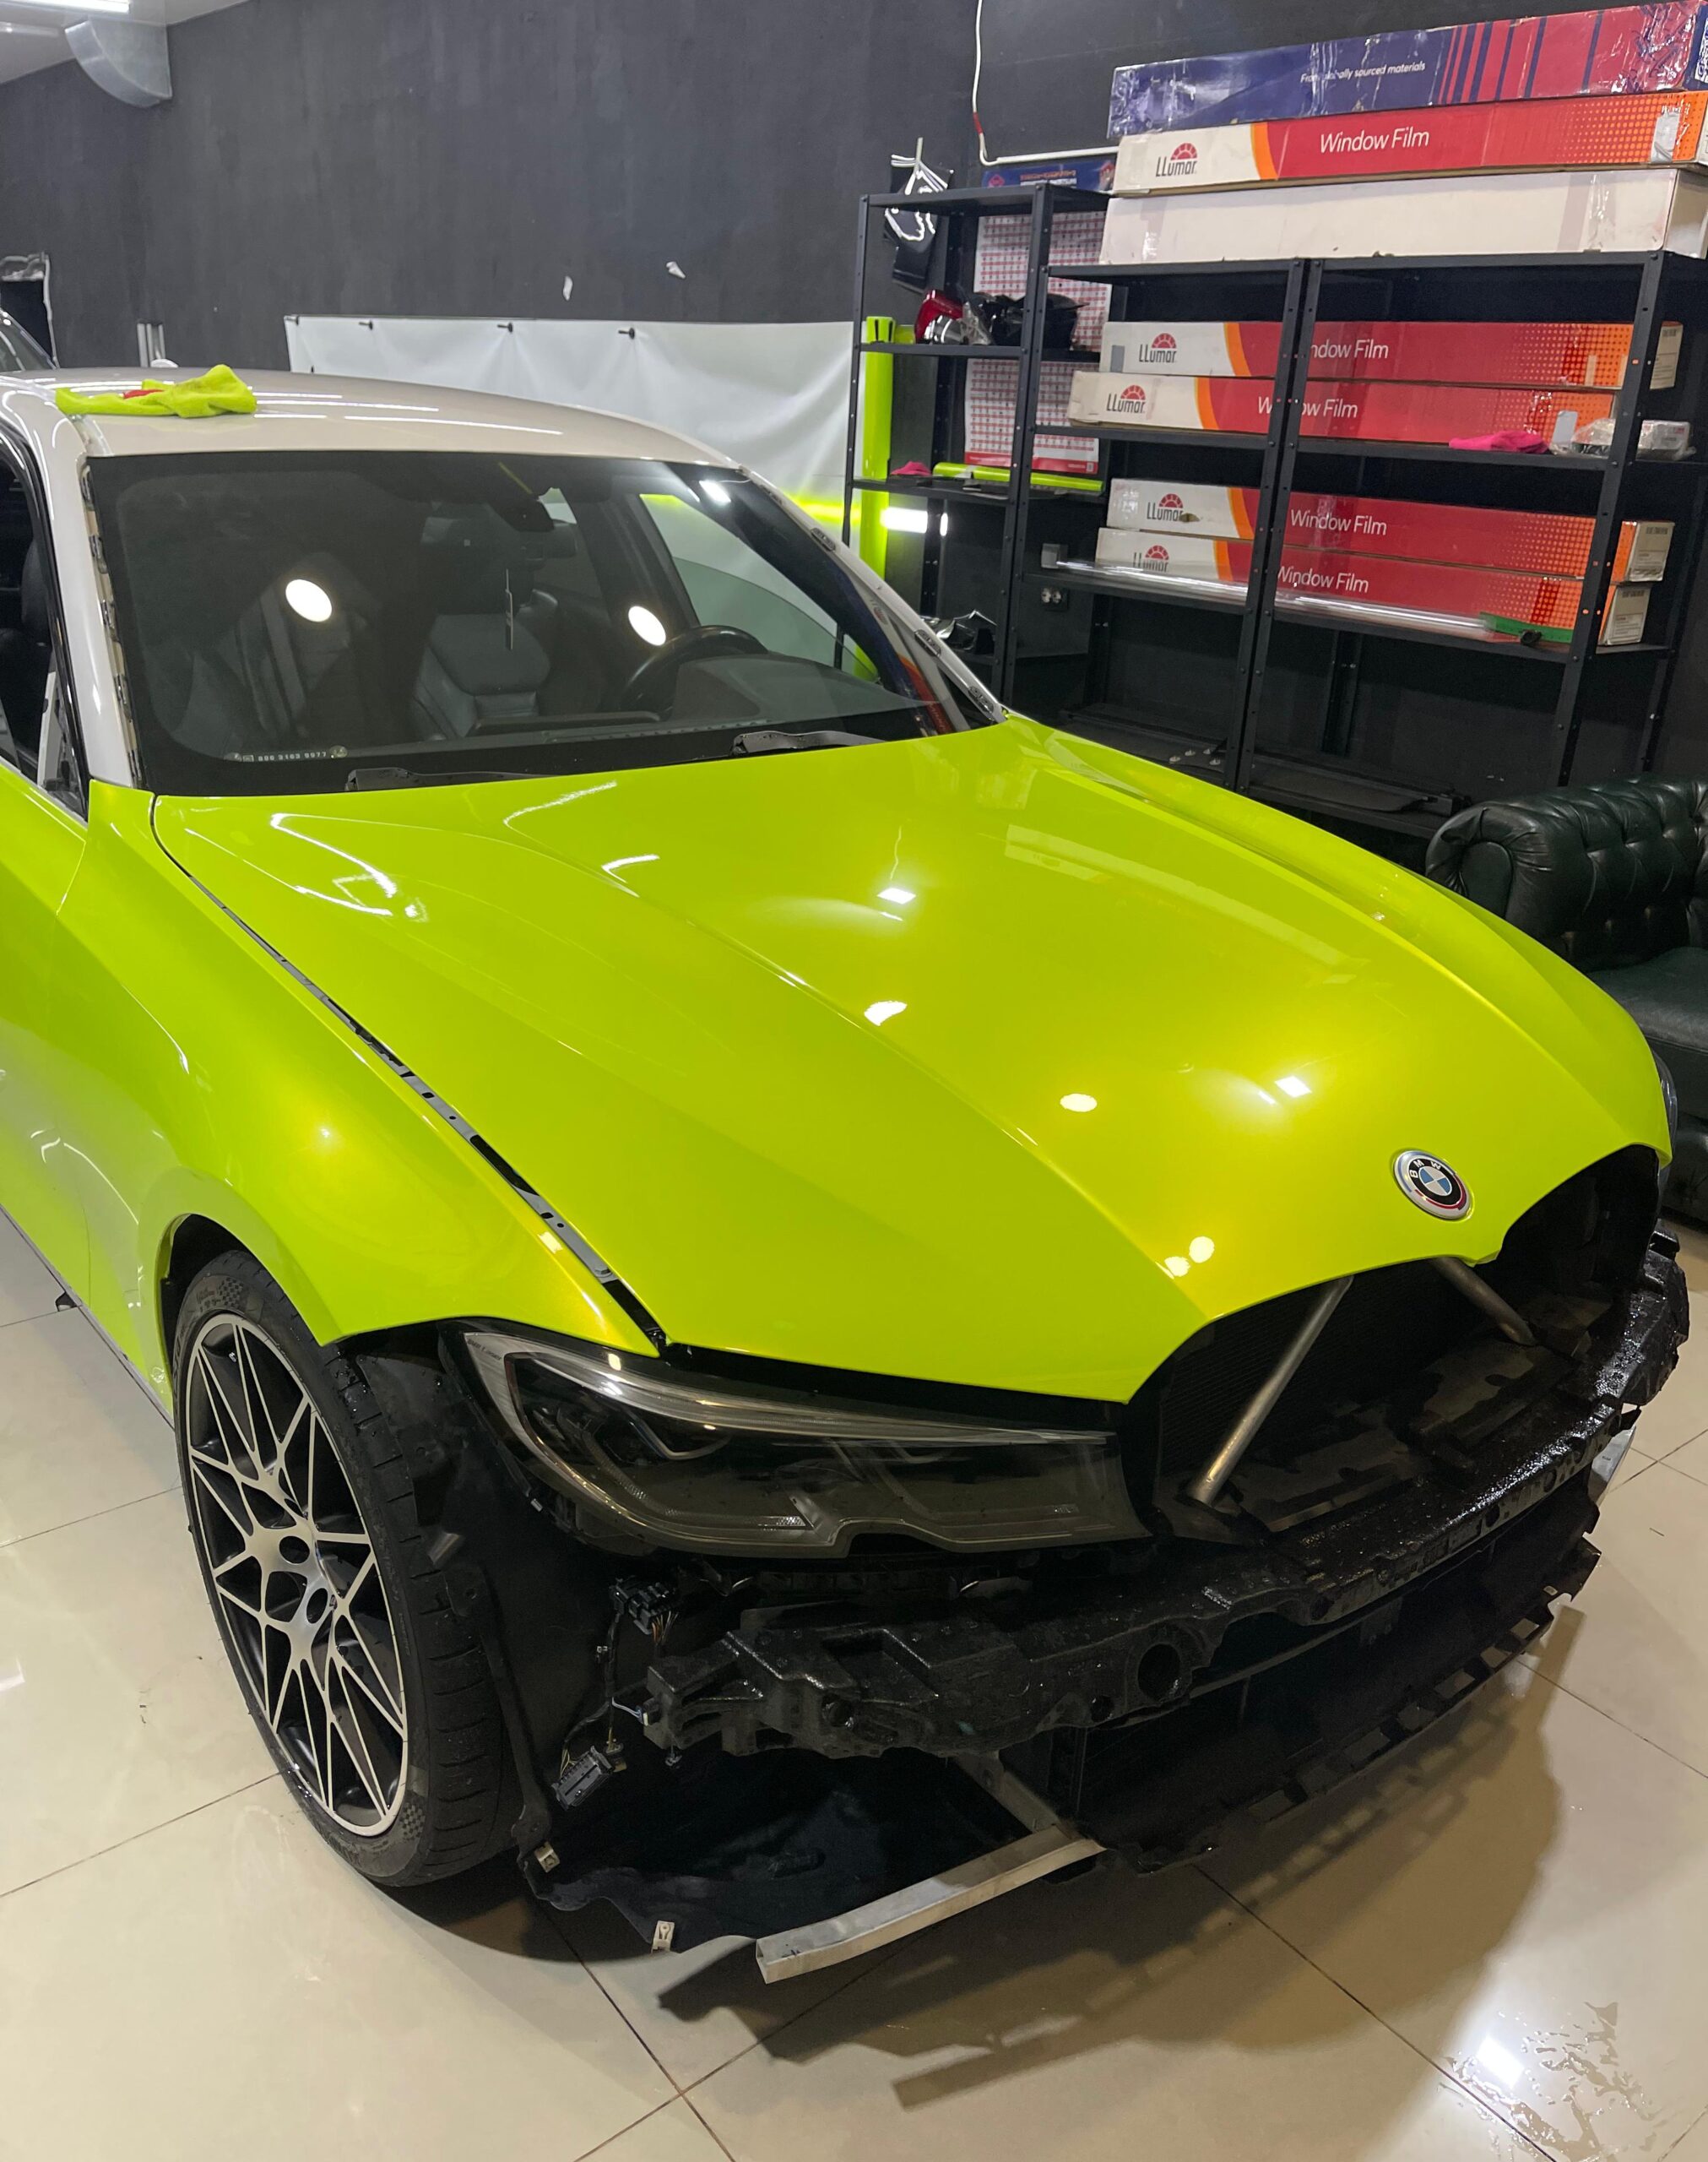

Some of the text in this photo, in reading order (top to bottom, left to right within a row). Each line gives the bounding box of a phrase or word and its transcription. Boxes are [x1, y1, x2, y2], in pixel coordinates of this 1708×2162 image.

[1354, 64, 1387, 78] sourced
[1387, 61, 1426, 74] materials
[1320, 126, 1430, 154] Window Film
[1155, 157, 1197, 177] LLumar
[1139, 344, 1178, 363] LLumar
[1310, 339, 1389, 359] ndow Film
[1106, 394, 1146, 414] LLumar
[1323, 399, 1358, 419] Film
[1290, 508, 1387, 535] Window Film
[1335, 573, 1369, 593] Film
[1409, 1159, 1442, 1178] BMW
